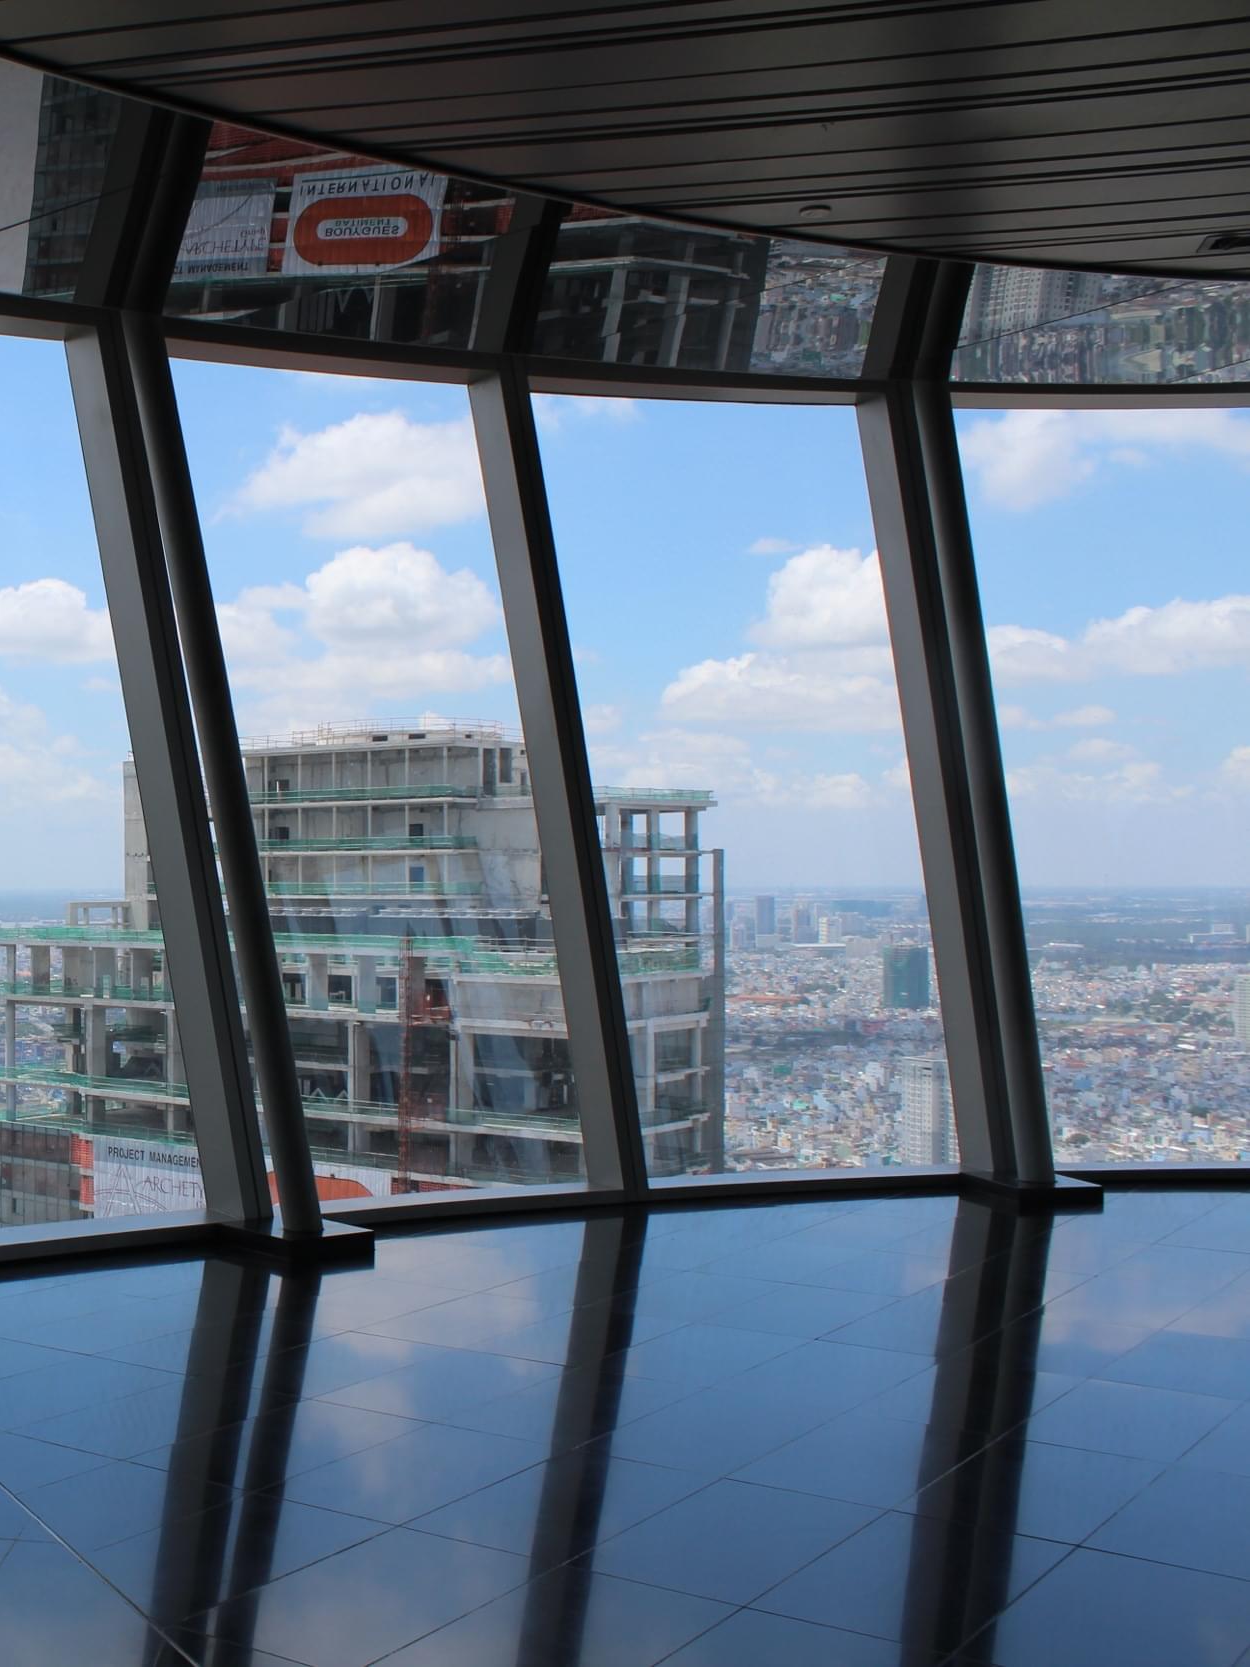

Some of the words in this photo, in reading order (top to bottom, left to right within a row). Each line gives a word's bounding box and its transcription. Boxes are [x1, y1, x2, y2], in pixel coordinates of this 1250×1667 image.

[108, 1146, 144, 1160] PROJECT
[150, 1151, 200, 1168] MANAGEMEN
[143, 1176, 203, 1198] ARCHETY
